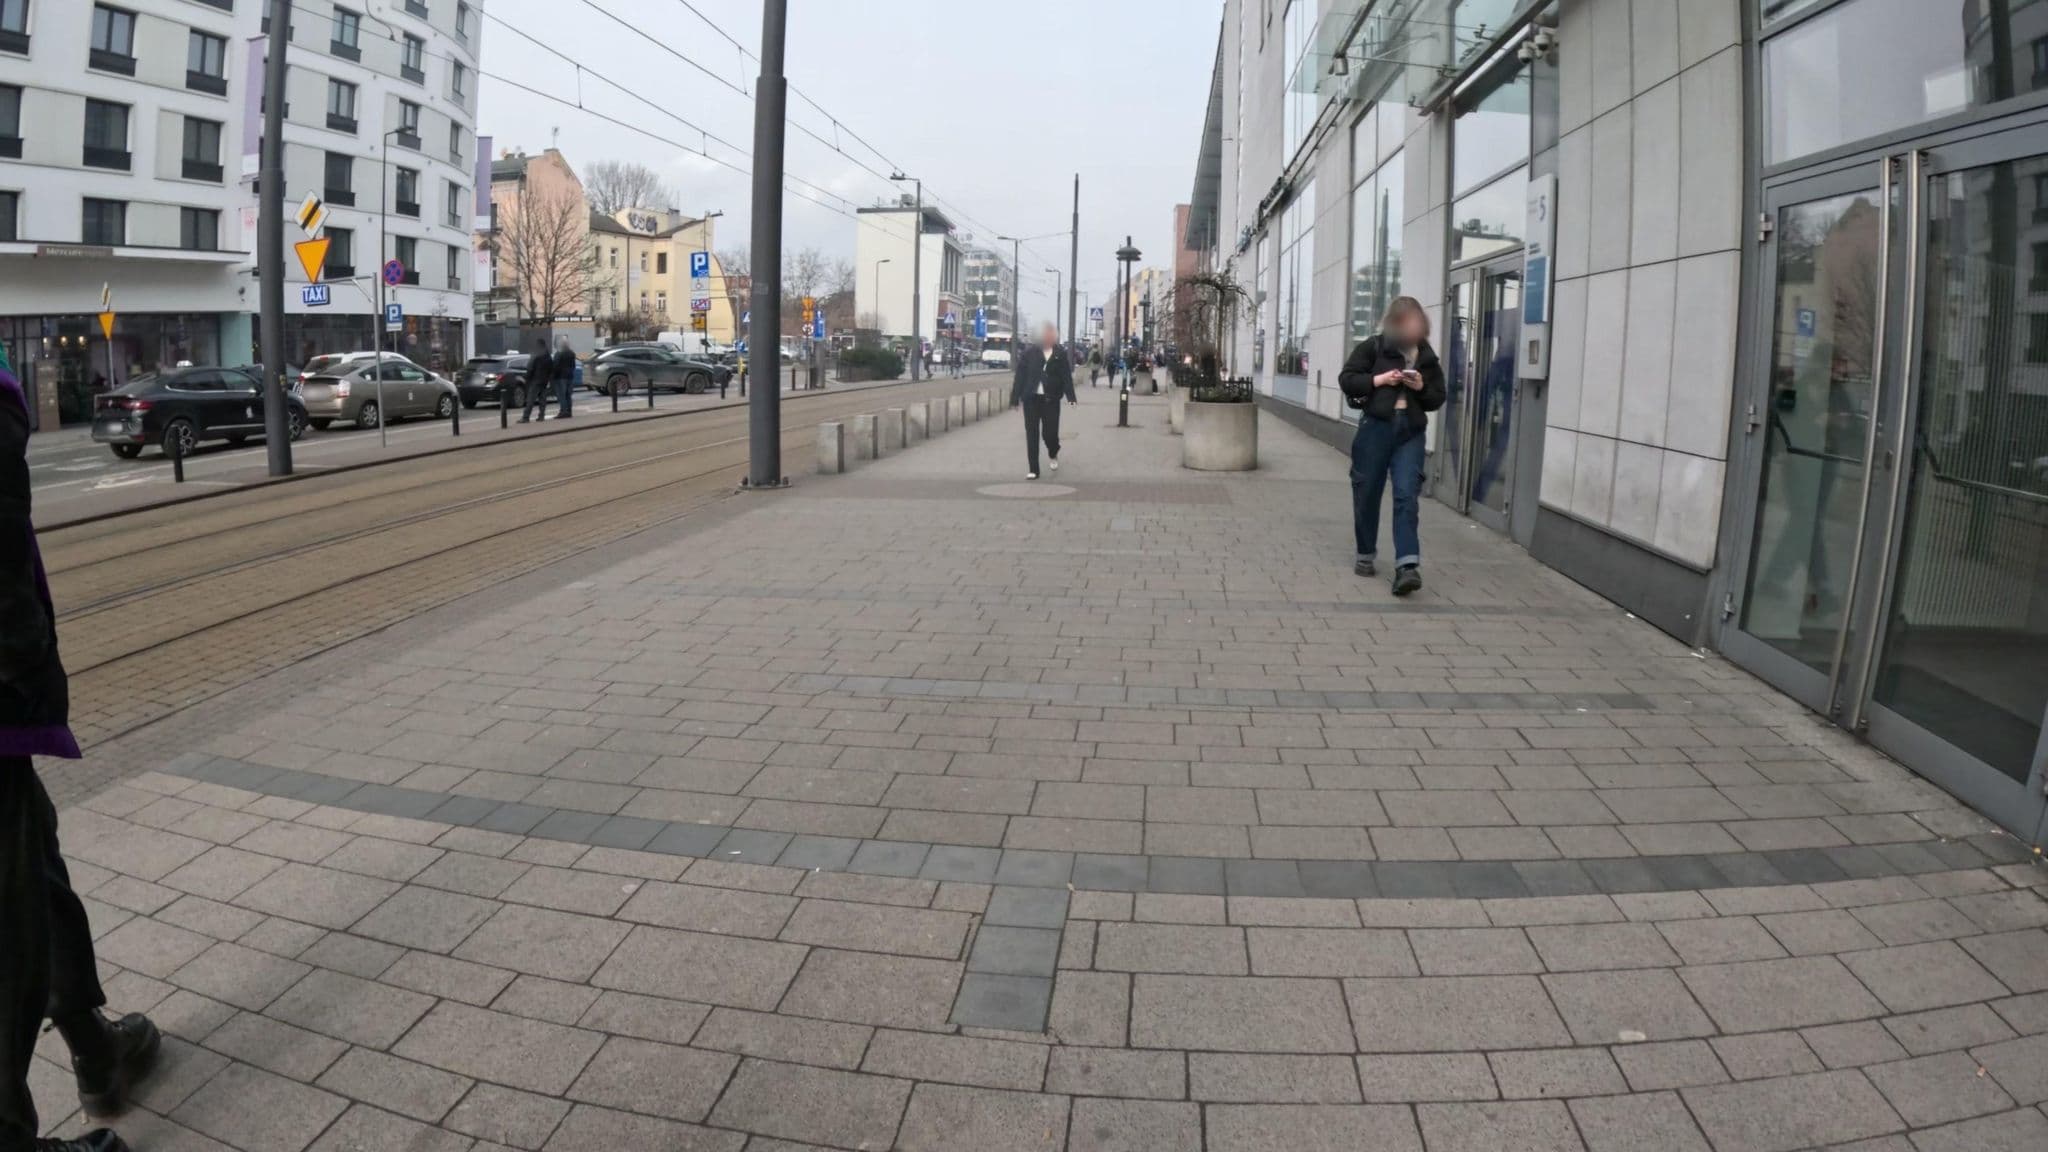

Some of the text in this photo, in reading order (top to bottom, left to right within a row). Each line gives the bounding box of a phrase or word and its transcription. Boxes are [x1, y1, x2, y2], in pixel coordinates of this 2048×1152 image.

[694, 254, 706, 271] P
[302, 286, 327, 302] TAXI
[389, 306, 399, 322] P
